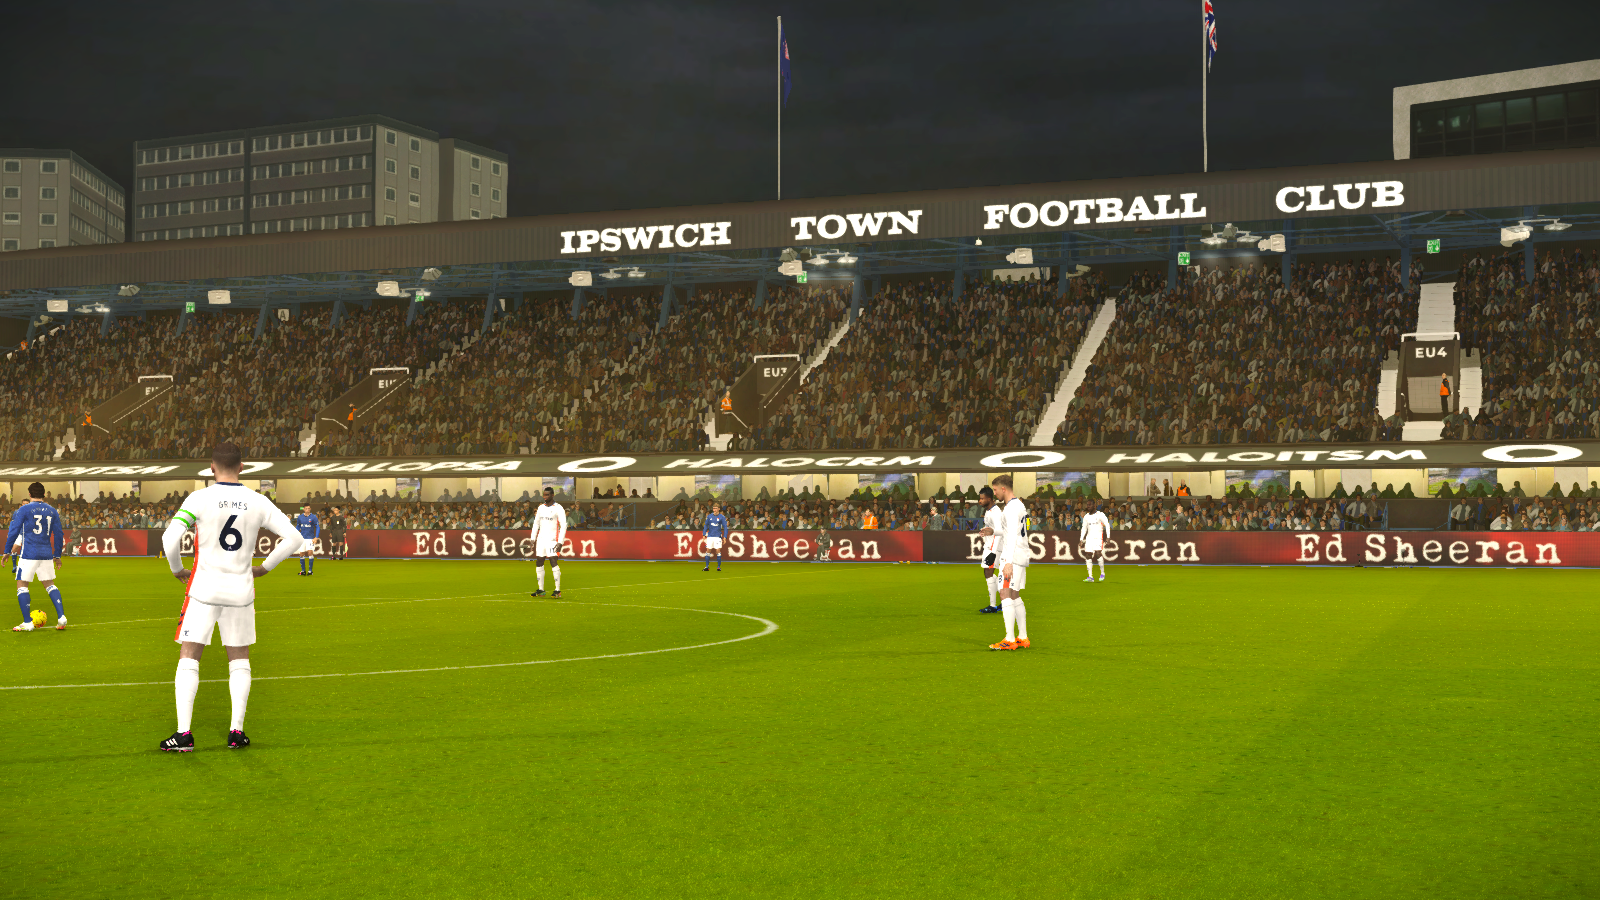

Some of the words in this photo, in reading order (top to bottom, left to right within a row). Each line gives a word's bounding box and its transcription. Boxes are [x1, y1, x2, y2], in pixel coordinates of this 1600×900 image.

[560, 221, 732, 254] IPSWICH
[791, 210, 923, 241] TOWN
[983, 193, 1207, 229] FOOTBALL
[1275, 181, 1405, 213] CLUB
[1415, 347, 1448, 358] EU4
[663, 456, 936, 469] HALOCRM
[1106, 450, 1428, 464] HALOITSM
[287, 460, 523, 473] HALOPSA
[218, 500, 248, 511] GRIMES
[32, 514, 53, 536] 31
[219, 514, 243, 552] 6
[413, 532, 449, 556] Ed
[461, 532, 599, 558] Sheean
[1296, 534, 1347, 562] Ed
[1365, 534, 1562, 564] Sheeran
